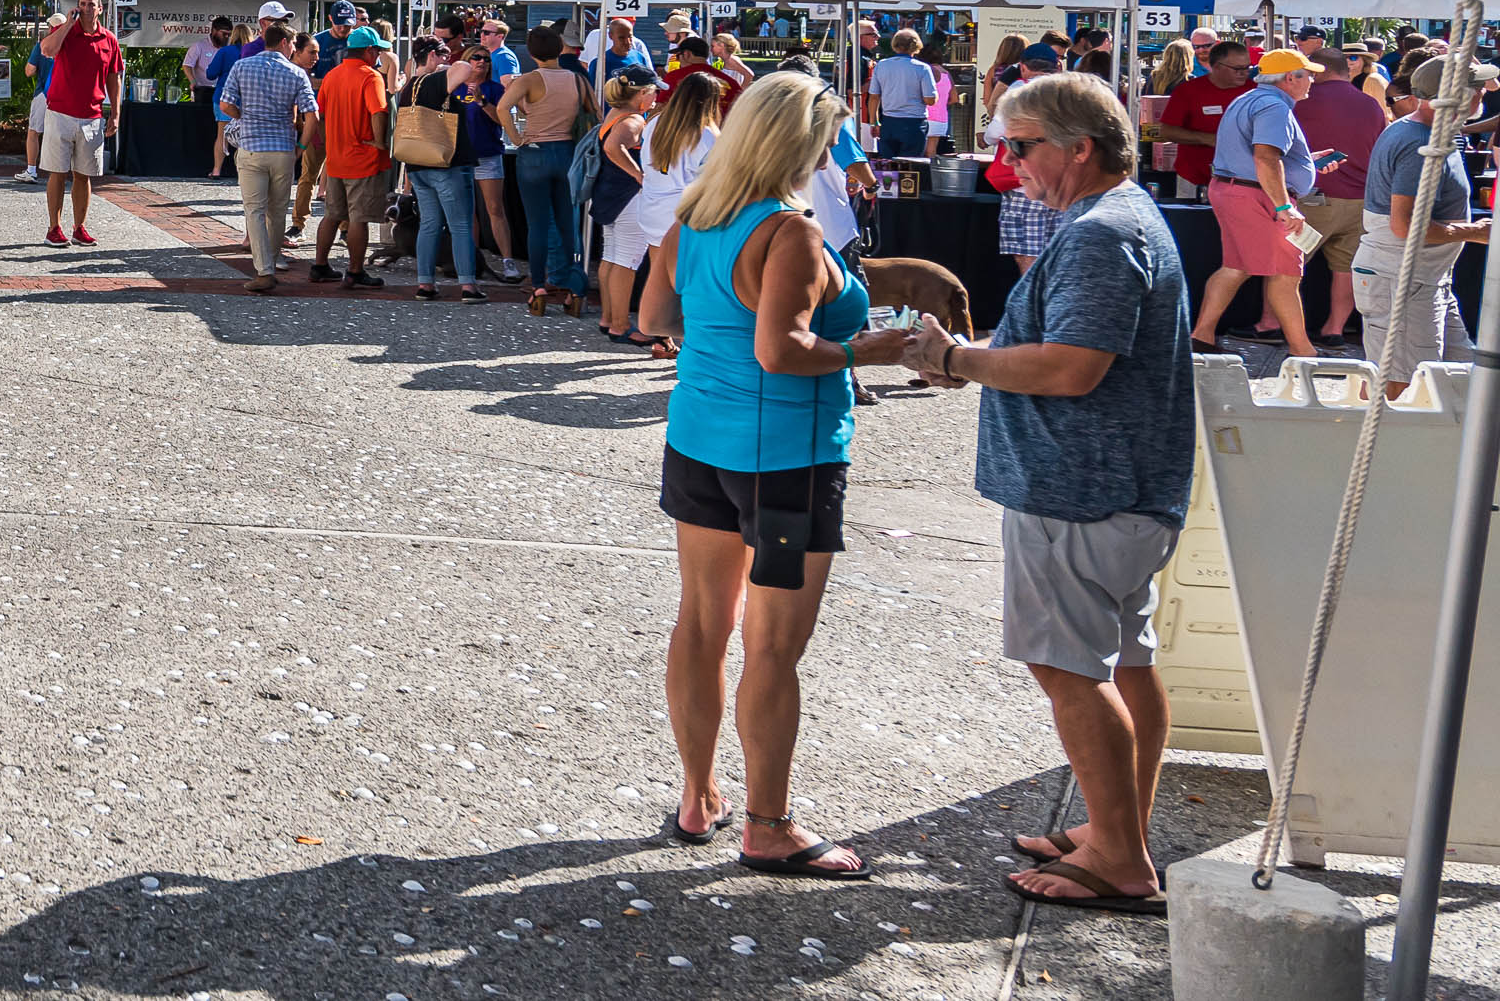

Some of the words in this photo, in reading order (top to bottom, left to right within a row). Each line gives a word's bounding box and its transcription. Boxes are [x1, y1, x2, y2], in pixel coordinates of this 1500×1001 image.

[715, 4, 732, 14] 40
[147, 12, 190, 22] ALWAYS
[193, 13, 205, 22] BE
[1145, 12, 1171, 26] 53
[1319, 16, 1334, 26] 38
